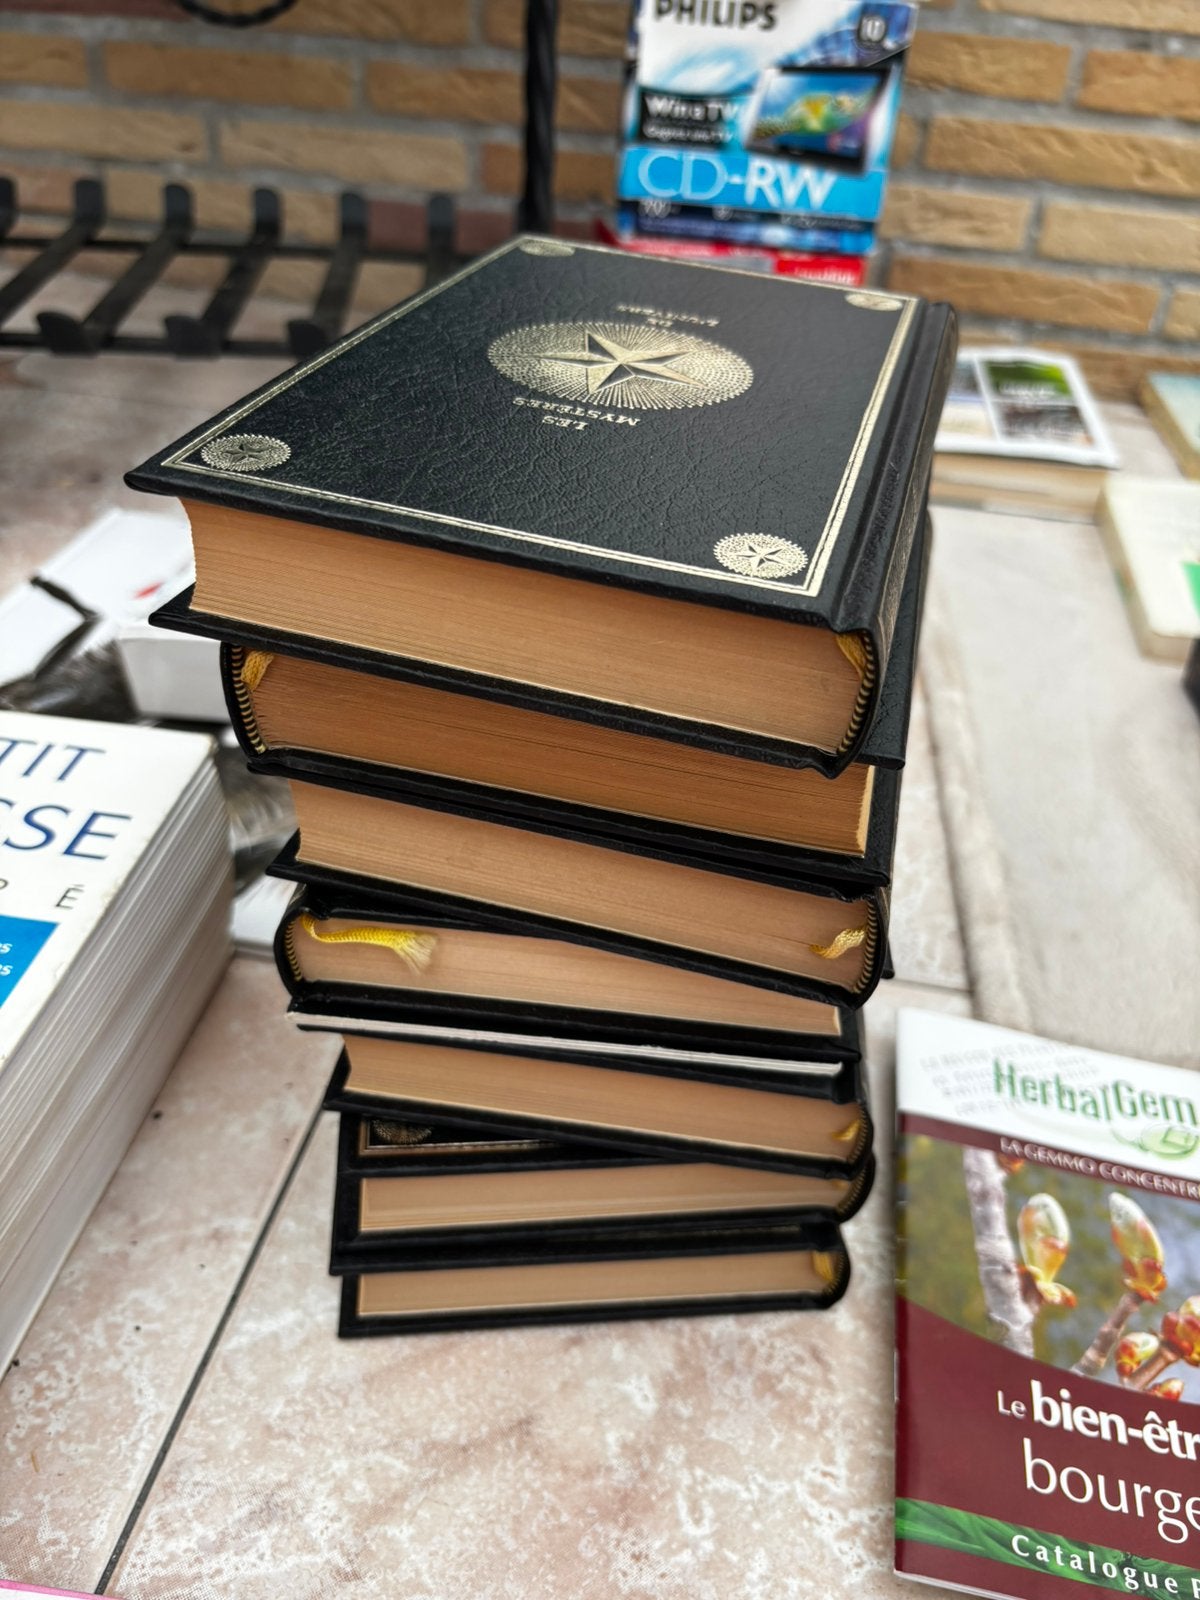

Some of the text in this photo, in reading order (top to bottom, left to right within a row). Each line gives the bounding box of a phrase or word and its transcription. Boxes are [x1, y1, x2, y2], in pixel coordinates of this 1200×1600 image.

[655, 0, 776, 31] PHILIPS
[706, 102, 738, 121] TV
[638, 151, 837, 210] CD-RW
[542, 415, 589, 431] LES
[0, 798, 132, 860] SE
[1001, 1137, 1023, 1158] LA
[1024, 1143, 1096, 1176] GEMMO
[997, 1390, 1026, 1419] Le
[1011, 1534, 1178, 1594] Catalogue
